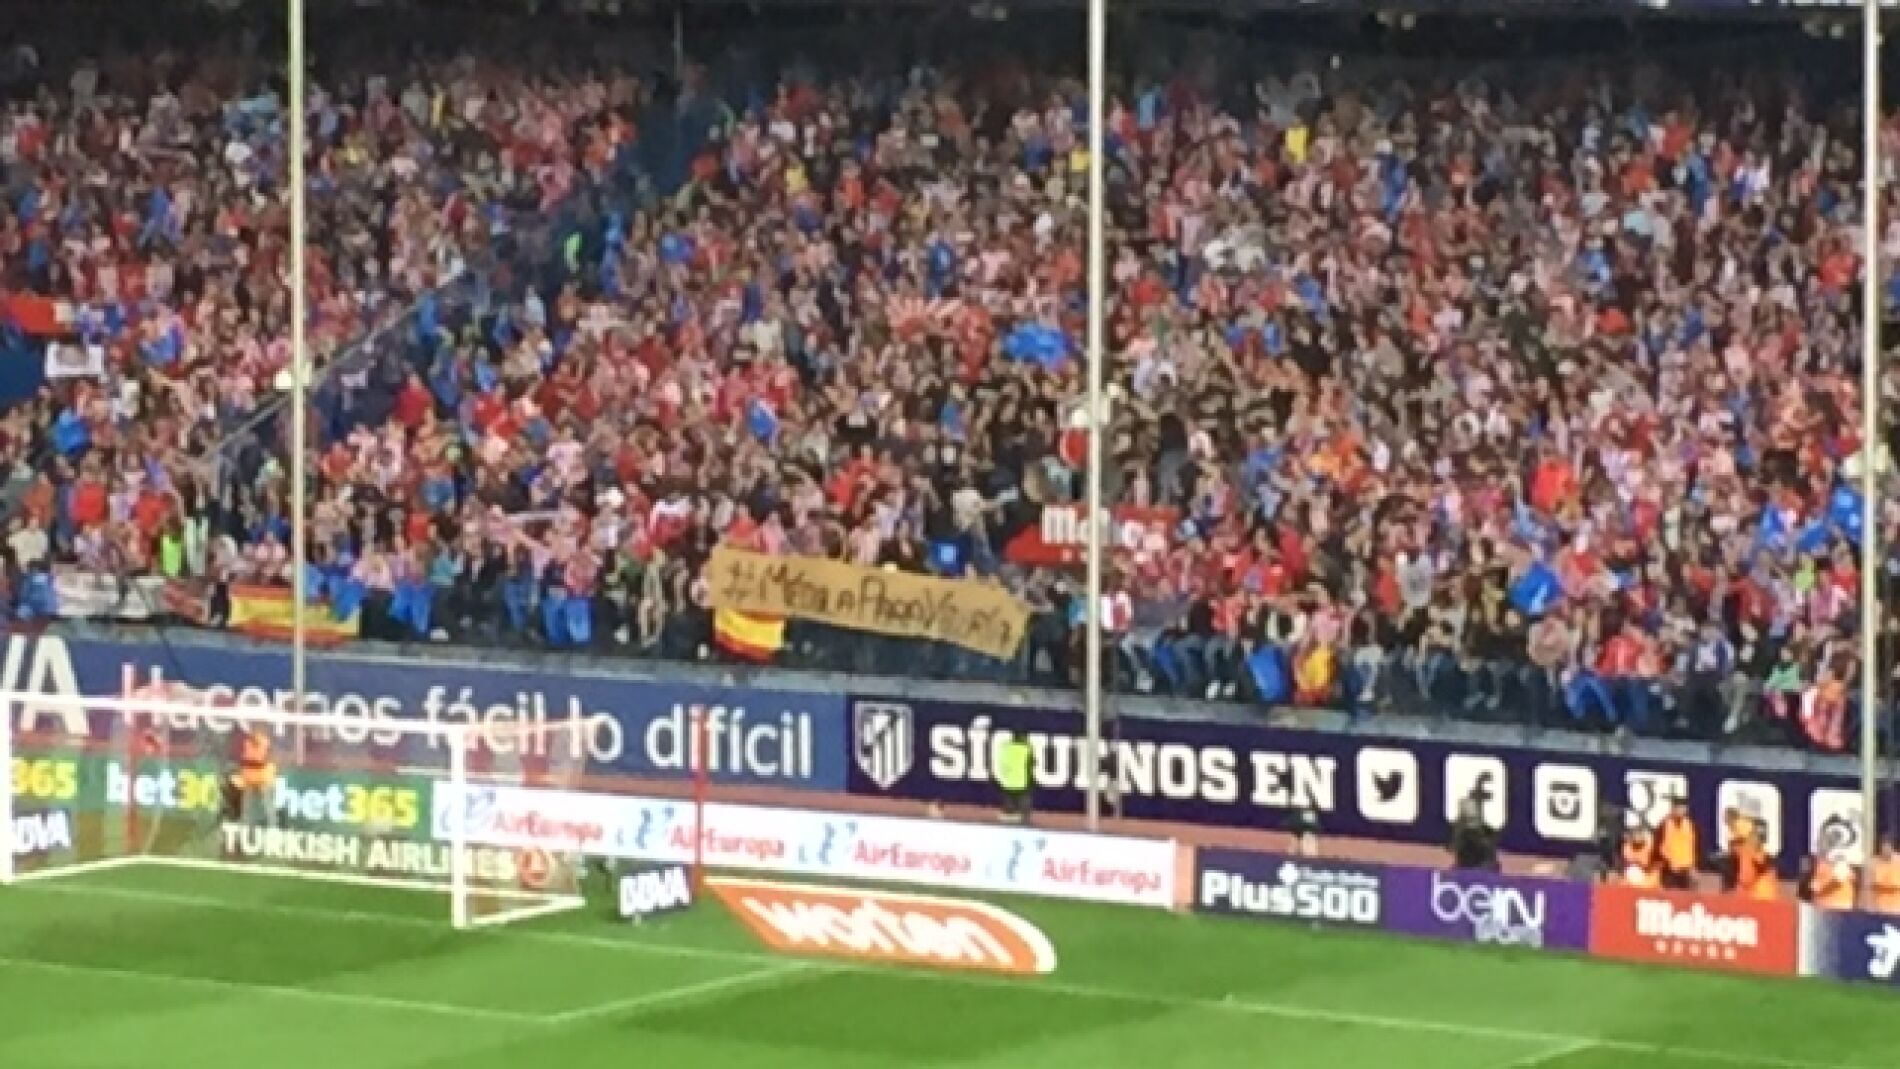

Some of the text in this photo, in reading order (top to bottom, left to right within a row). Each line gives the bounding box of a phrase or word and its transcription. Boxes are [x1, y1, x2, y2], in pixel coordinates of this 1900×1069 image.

[422, 685, 546, 756] fácil
[569, 694, 624, 764] lo
[644, 703, 814, 777] difícil
[928, 716, 1338, 811] SÍUENOS EN
[221, 822, 517, 880] TURKISH AIRLIES
[853, 840, 972, 876] AirEuropa
[1041, 857, 1161, 892] AirEuropa
[1201, 870, 1379, 923] Plus500
[1635, 897, 1759, 947] Mahou
